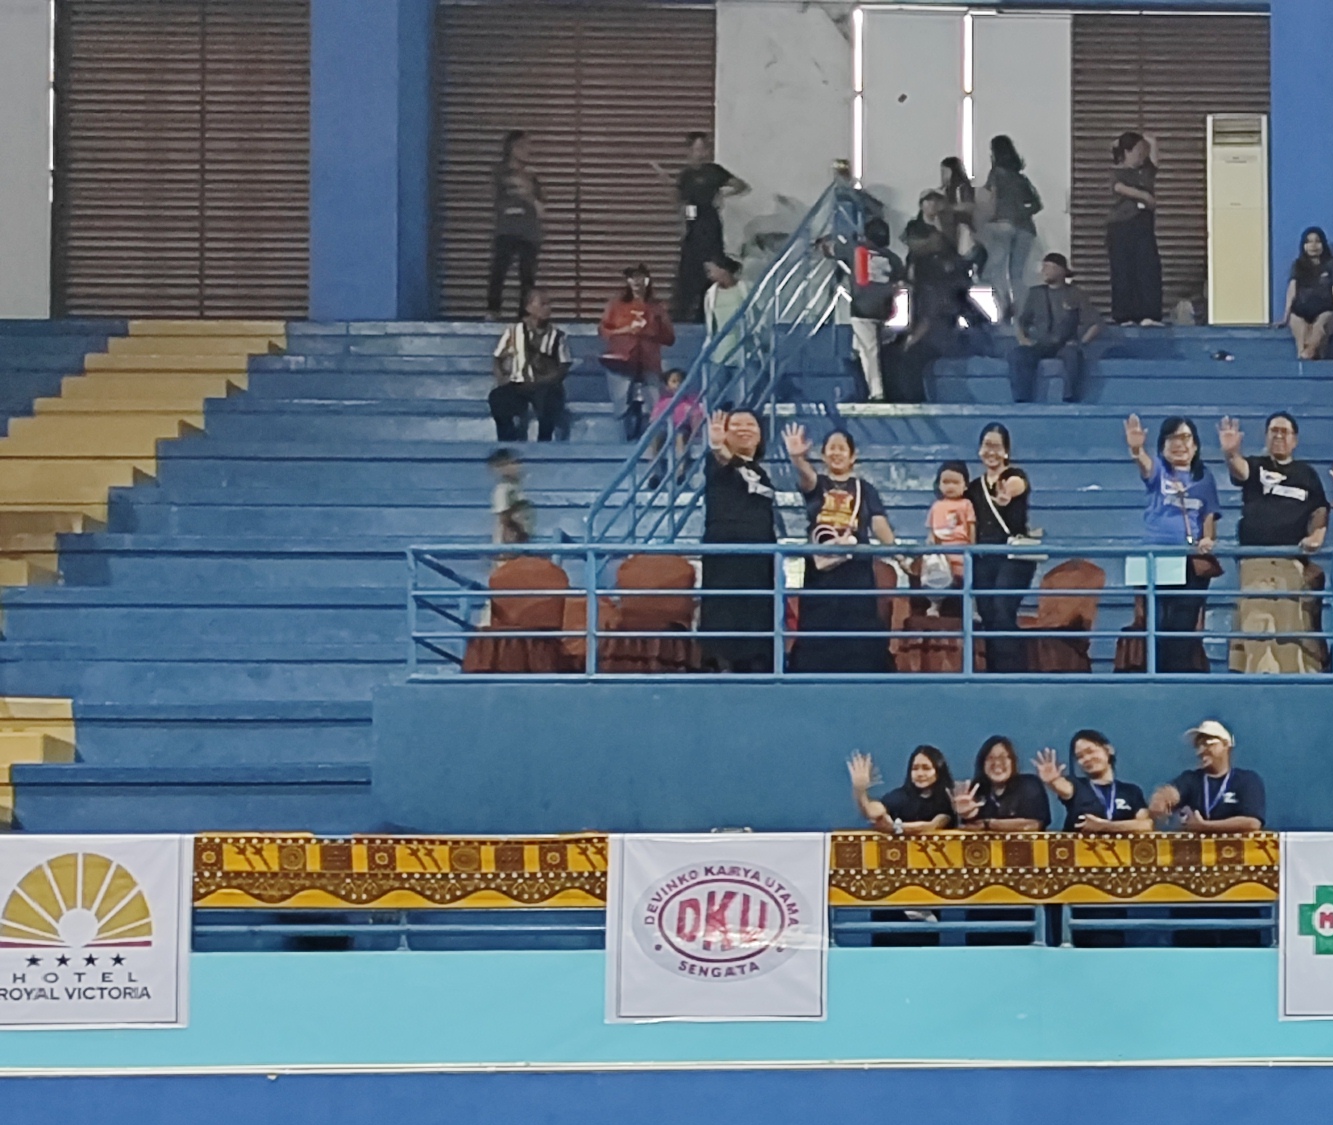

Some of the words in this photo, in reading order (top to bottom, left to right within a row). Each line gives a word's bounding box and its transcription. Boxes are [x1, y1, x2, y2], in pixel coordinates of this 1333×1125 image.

[645, 870, 699, 925] DEVINKO
[704, 865, 761, 882] KARYA
[764, 877, 800, 927] UTAMA
[676, 891, 769, 951] DKU
[678, 960, 760, 977] SENGATA
[12, 972, 138, 983] HOTEL
[0, 987, 60, 1000] ROYAL
[65, 986, 152, 1000] VICTORIA
